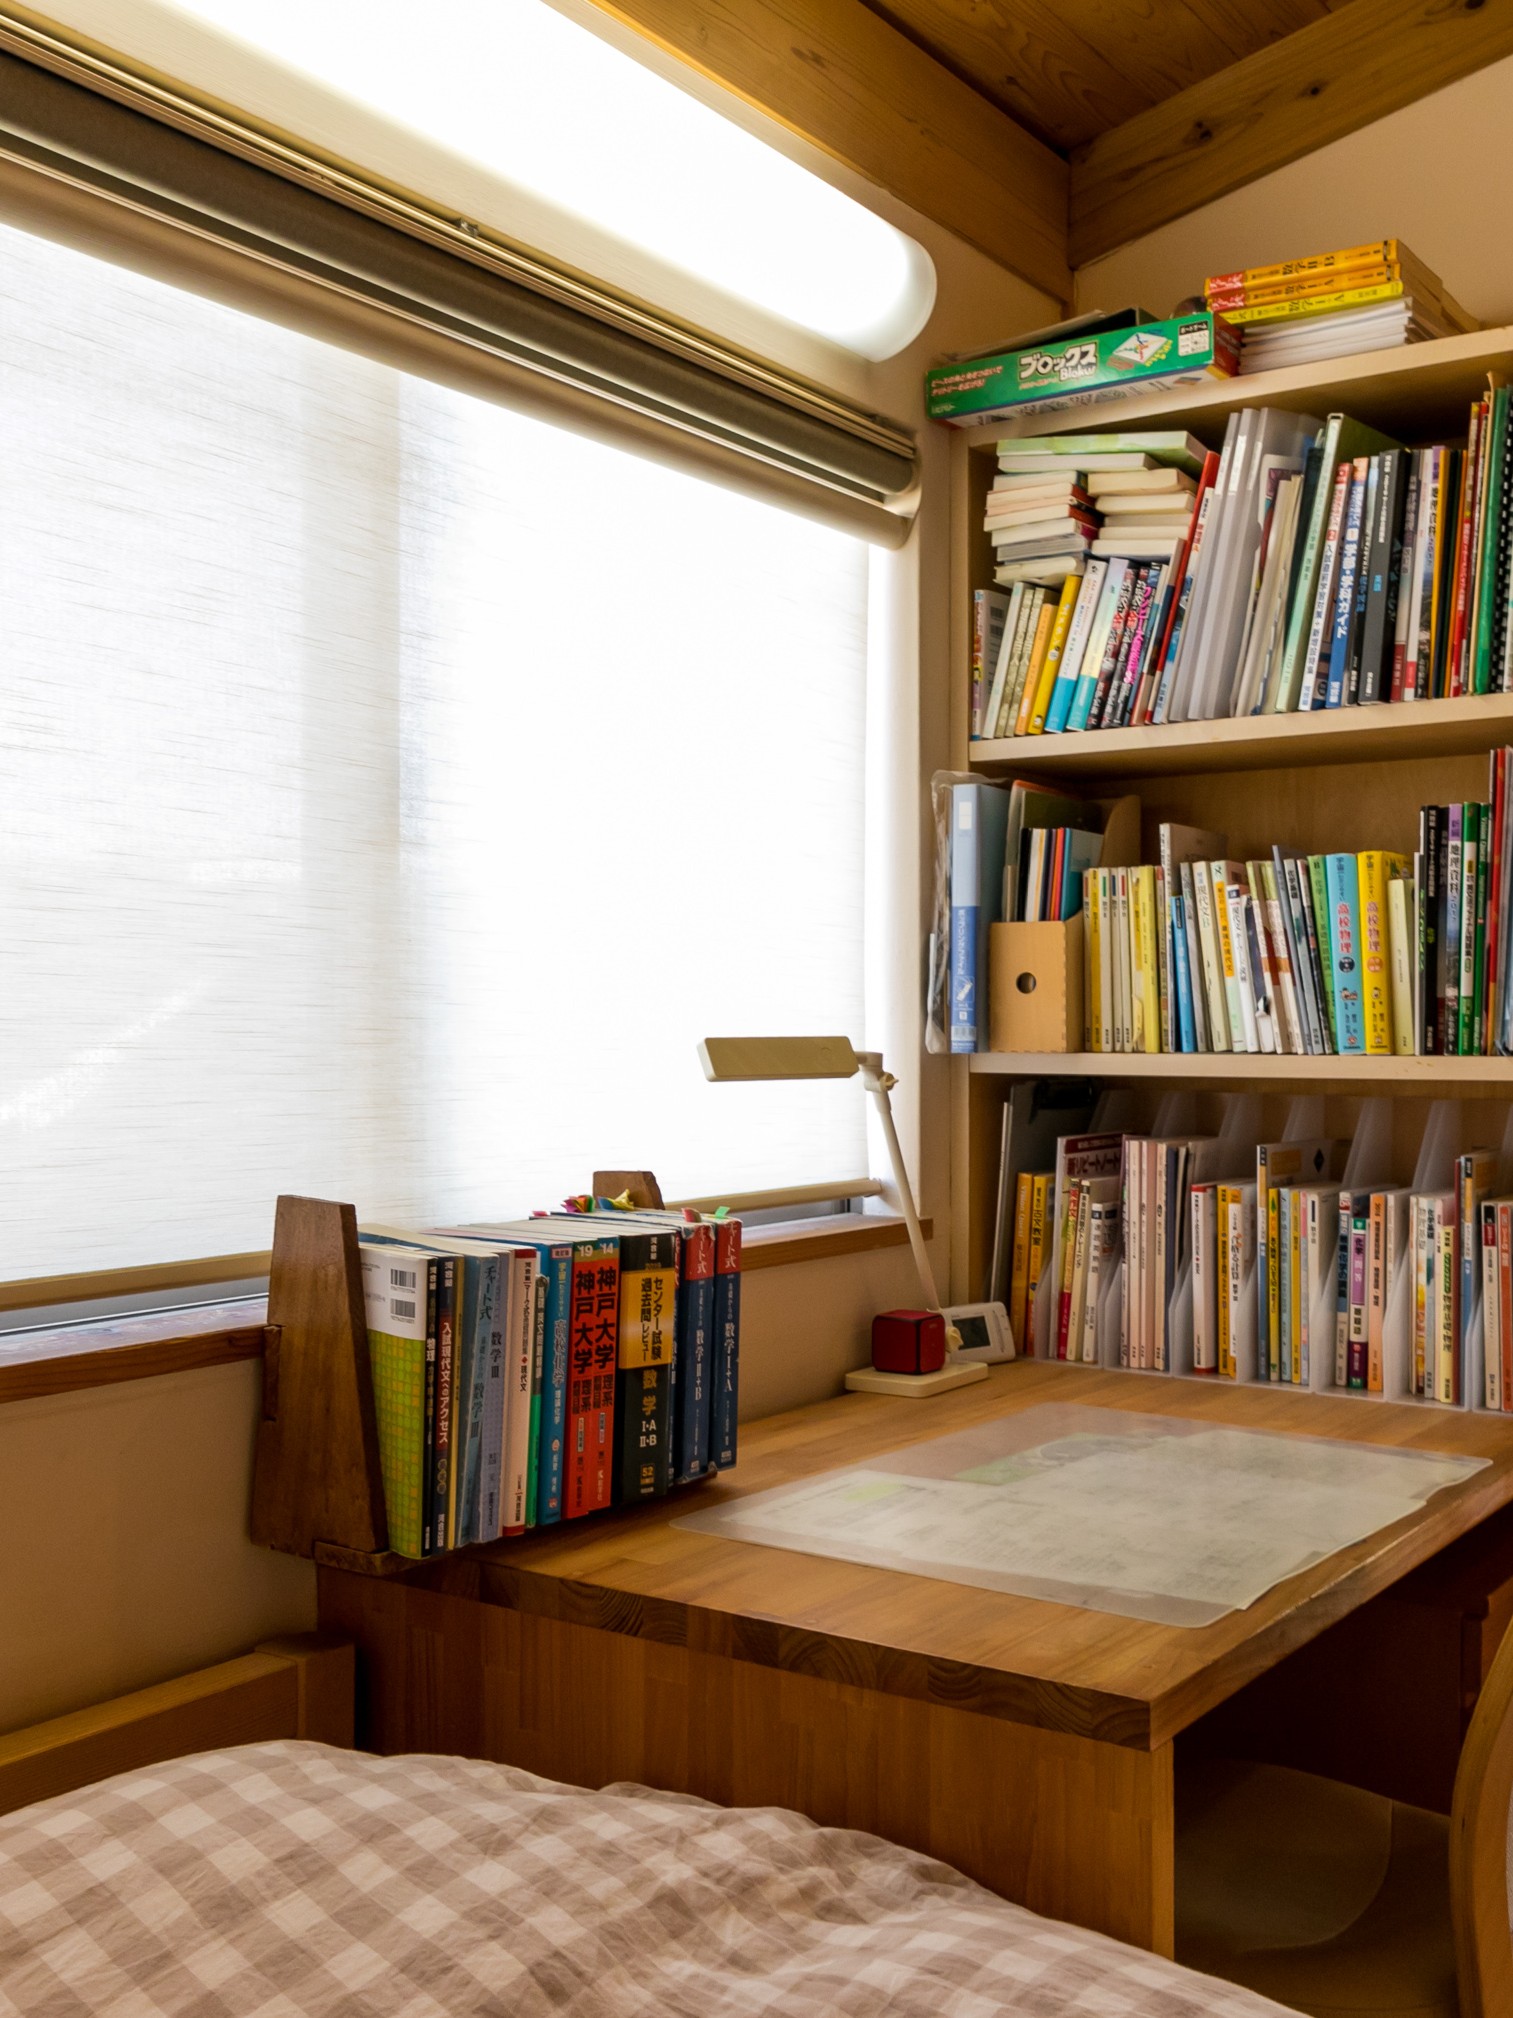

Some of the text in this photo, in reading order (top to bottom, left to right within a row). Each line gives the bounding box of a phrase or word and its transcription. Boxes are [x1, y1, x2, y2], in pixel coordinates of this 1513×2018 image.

[1019, 341, 1098, 379] ブロックス
[1337, 902, 1352, 954] 高校物理
[1367, 901, 1381, 953] 高校物理
[650, 1237, 658, 1260] 河合塾
[1427, 1208, 1436, 1240] 化学基礎
[429, 1265, 437, 1290] 河合塾
[480, 1265, 497, 1320] チャート式
[574, 1270, 596, 1375] 神戸大学
[594, 1266, 617, 1370] 神戸大学
[641, 1277, 653, 1362] 過去問レビュー
[652, 1276, 663, 1360] センター試験
[439, 1261, 454, 1444] 河合塾 入試現代文へのアクセス
[642, 1369, 657, 1416] 数学
